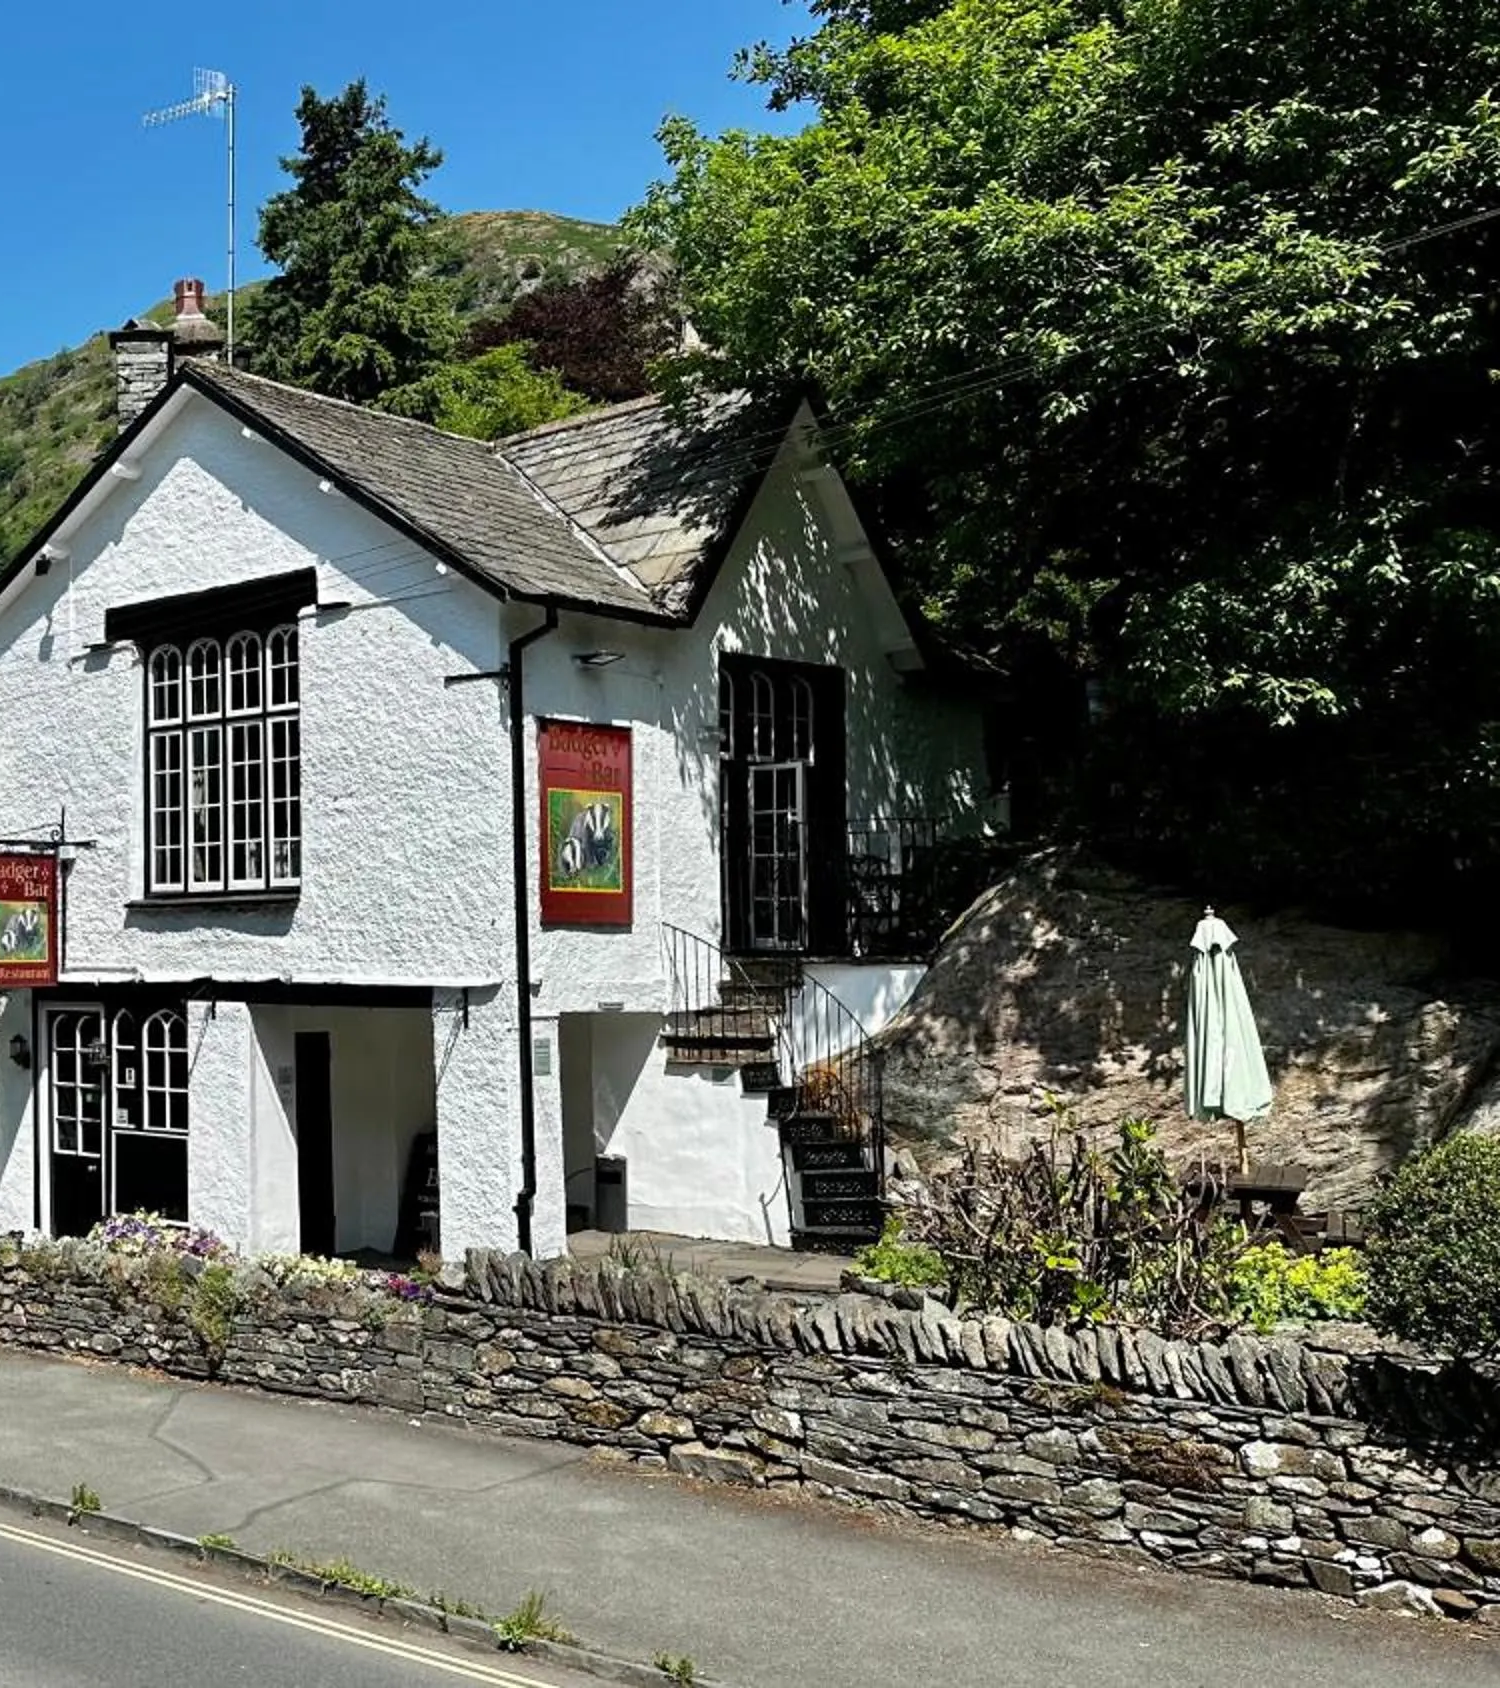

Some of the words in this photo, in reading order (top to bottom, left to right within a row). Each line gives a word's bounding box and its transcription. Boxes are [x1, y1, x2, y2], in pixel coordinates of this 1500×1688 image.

[548, 727, 608, 761] Badger
[592, 761, 620, 785] Bar
[24, 880, 49, 897] Bar
[0, 967, 50, 980] Restaurant
